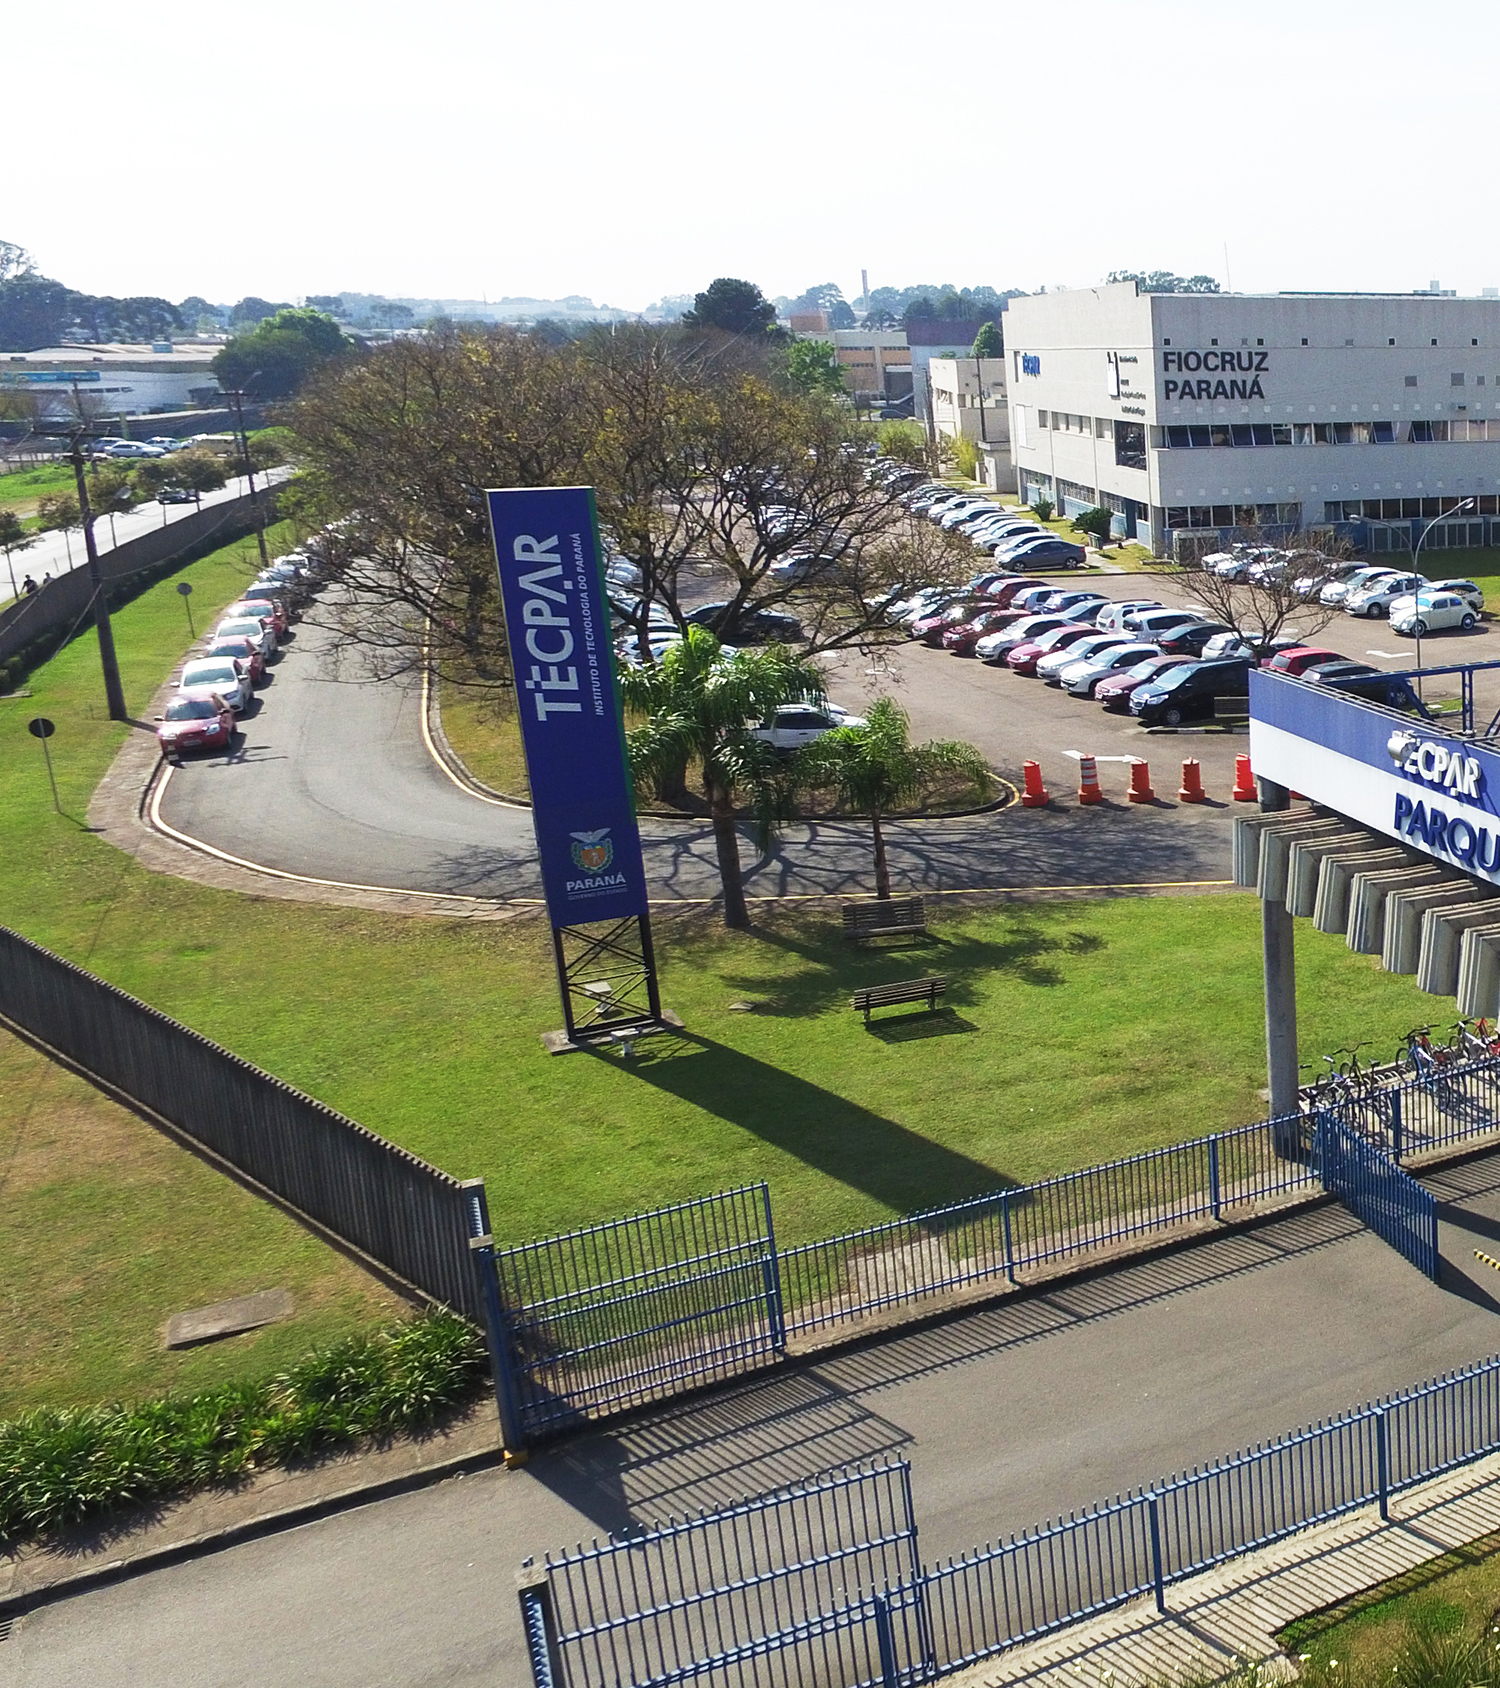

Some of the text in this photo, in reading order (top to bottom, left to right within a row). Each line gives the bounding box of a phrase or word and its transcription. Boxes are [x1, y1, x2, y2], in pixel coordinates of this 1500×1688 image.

[1163, 351, 1269, 372] FIOCRUZ
[1164, 373, 1265, 400] PARANÁ
[513, 534, 582, 722] TECPAR
[569, 533, 604, 716] INSTITUTO DE TECNOLOGIA DO PARANÁ
[566, 872, 627, 892] PARANÁ
